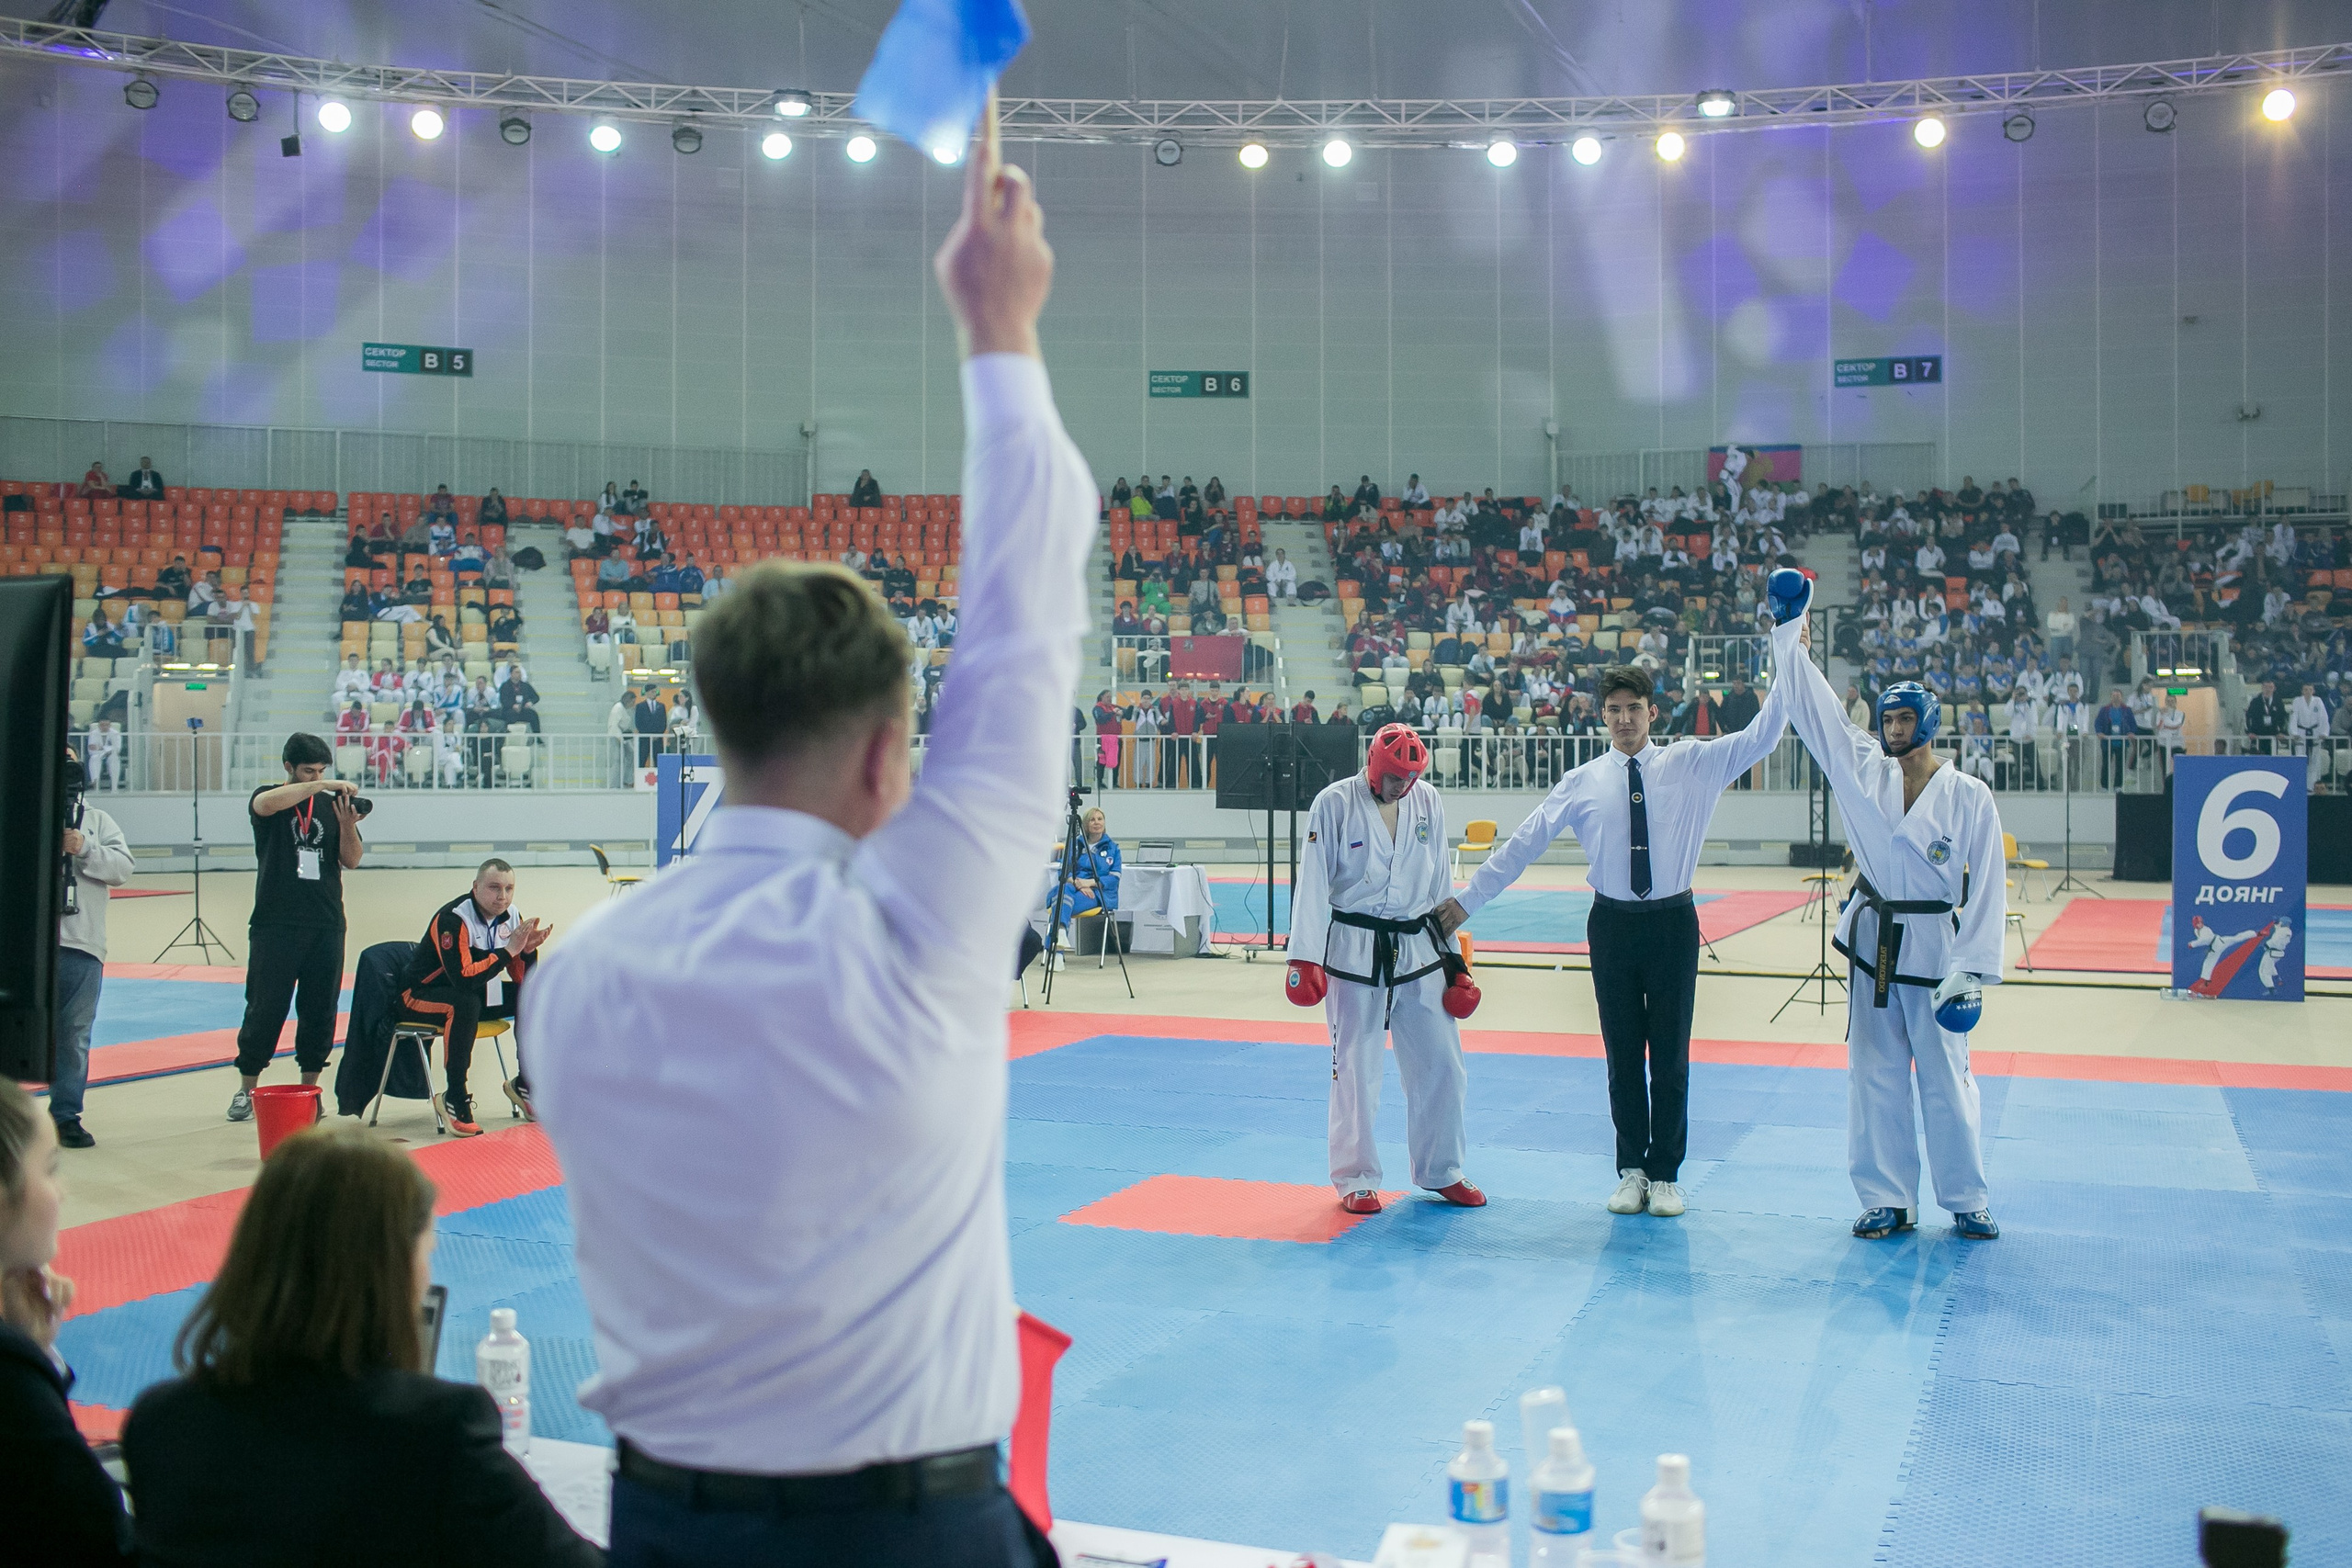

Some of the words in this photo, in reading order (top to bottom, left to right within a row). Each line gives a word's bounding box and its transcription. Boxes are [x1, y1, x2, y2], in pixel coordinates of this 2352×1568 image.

[365, 347, 406, 357] СЕКТОР
[366, 359, 399, 368] SECTOR
[453, 355, 464, 369] 5
[1921, 362, 1932, 378] 7
[1151, 375, 1188, 383] СЕКТОР
[1231, 378, 1241, 391] 6
[672, 765, 726, 849] 7
[2197, 770, 2290, 880] 6
[2195, 885, 2283, 905] ДОЯНГ
